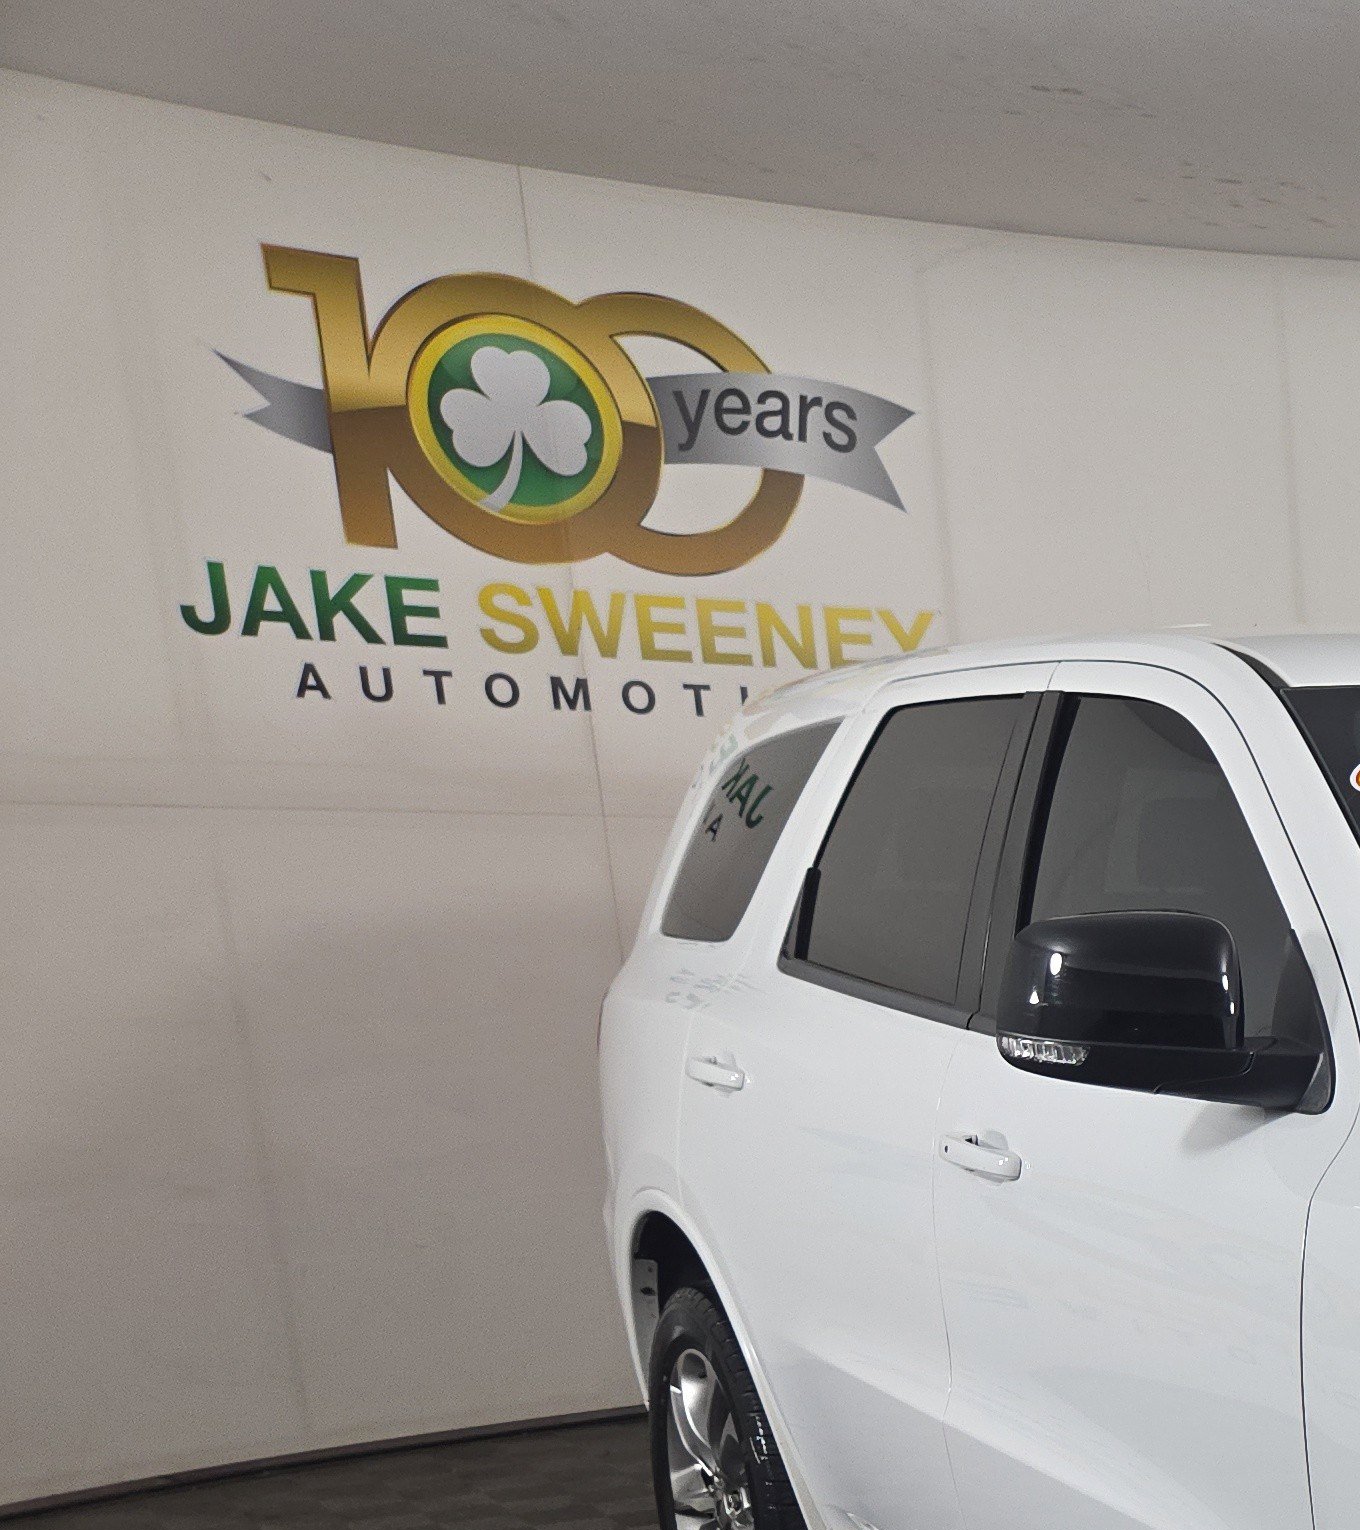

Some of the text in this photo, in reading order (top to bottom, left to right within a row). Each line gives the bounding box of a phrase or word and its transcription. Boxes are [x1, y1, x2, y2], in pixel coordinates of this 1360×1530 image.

[261, 243, 805, 577] 100
[672, 386, 858, 453] years
[180, 560, 935, 672] JAKE SWEENEY
